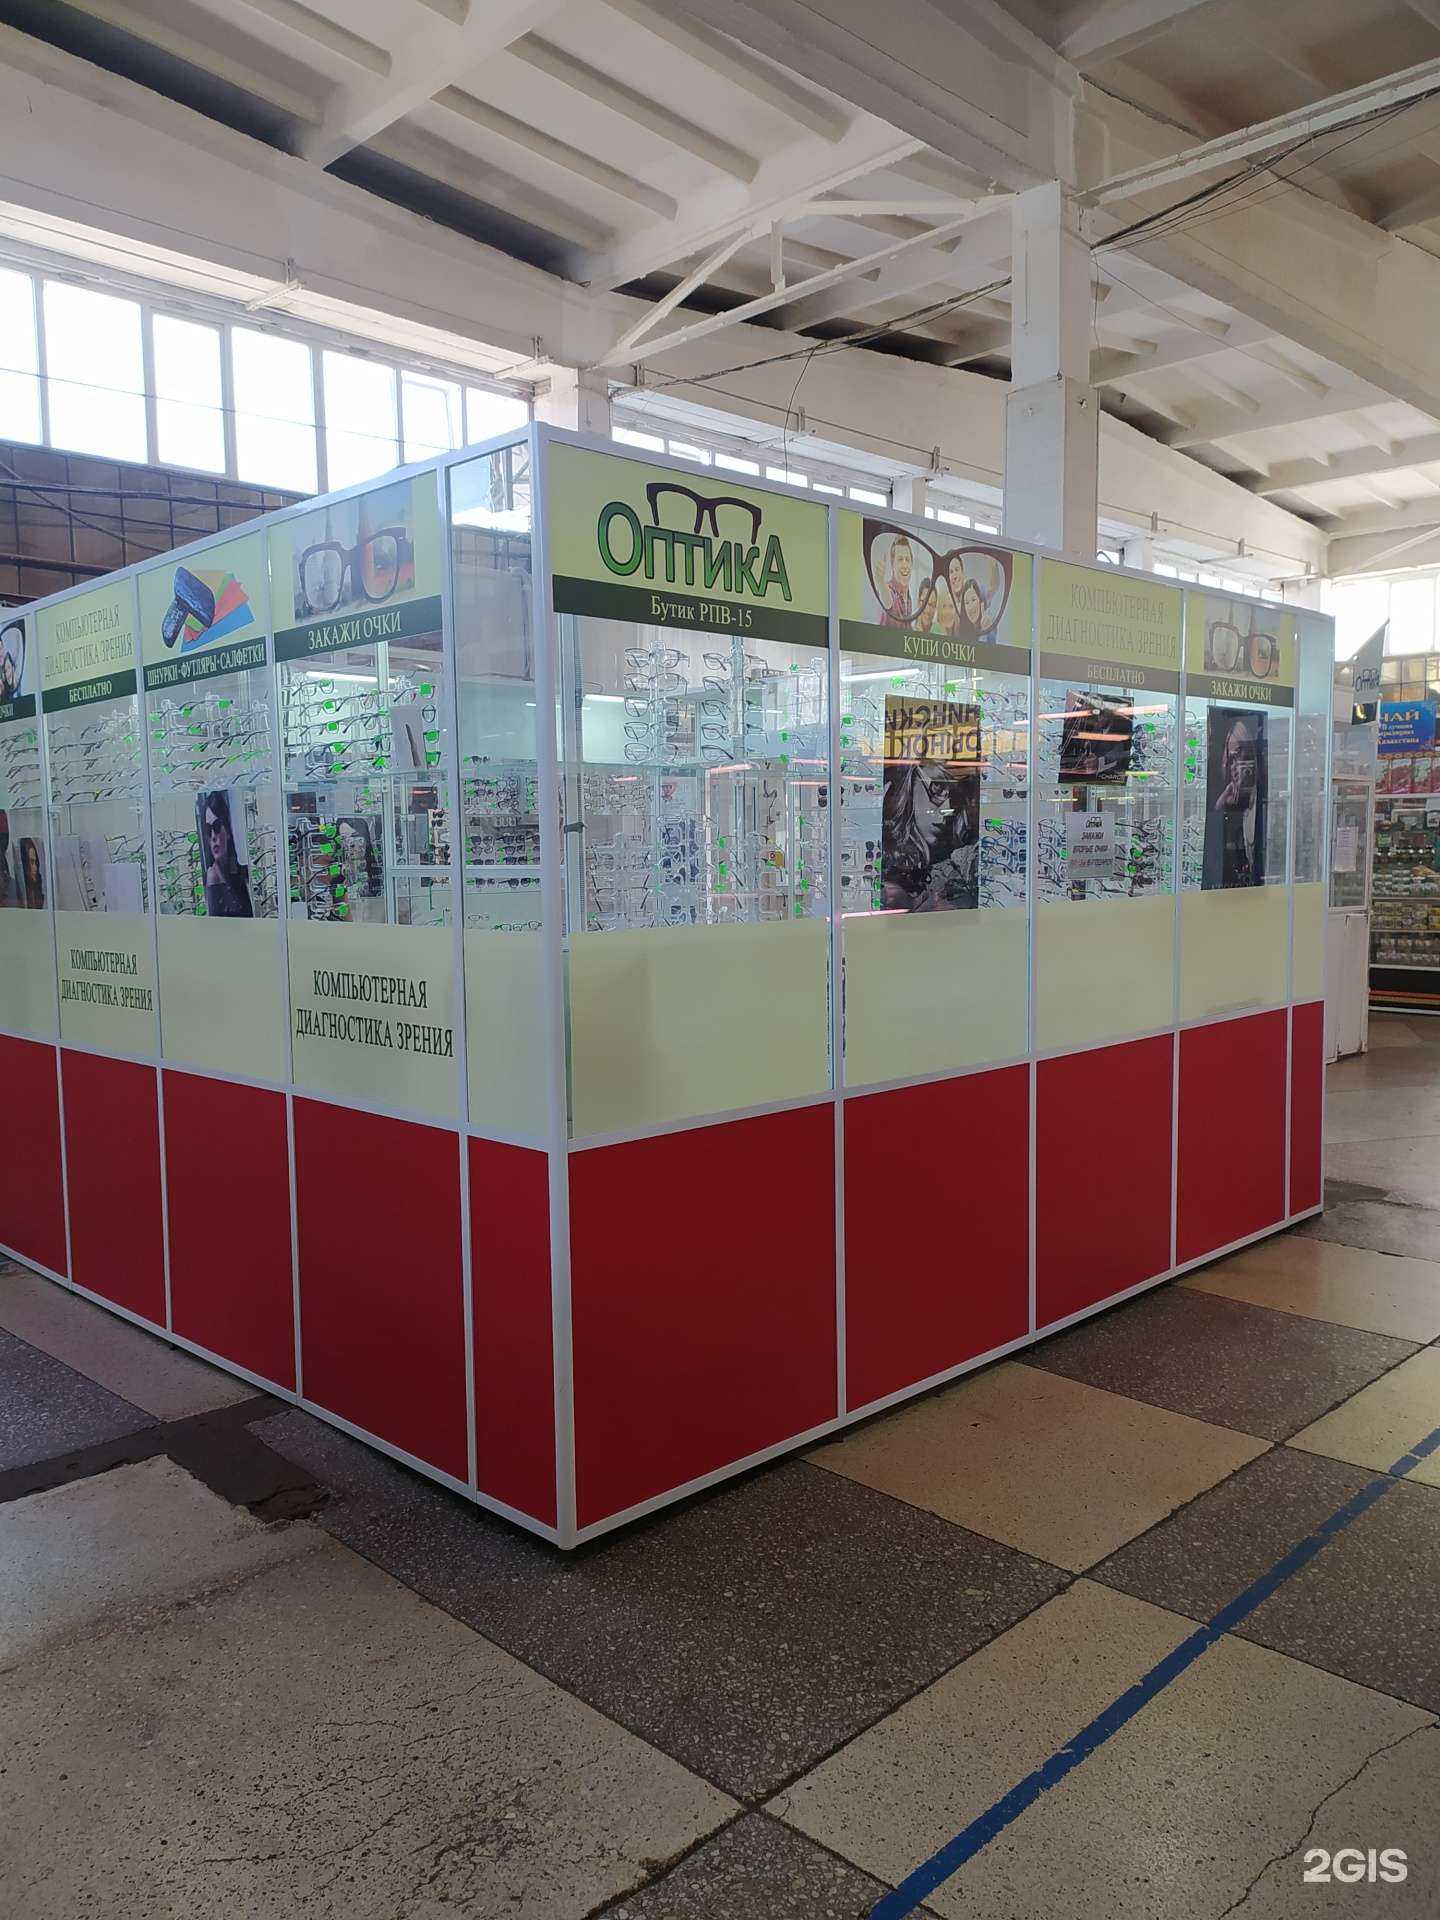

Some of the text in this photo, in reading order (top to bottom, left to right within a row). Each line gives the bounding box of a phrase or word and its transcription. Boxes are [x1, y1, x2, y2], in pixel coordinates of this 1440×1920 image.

[651, 595, 752, 628] Бутик РПВ-15
[1071, 583, 1164, 624] КОМПЬЮТЕРНАЯ
[56, 604, 120, 644] КОМПЬЮТЕРНАЯ
[308, 611, 401, 650] ЗАКАЖИ ОЧКИ
[1047, 614, 1177, 659] ДИАГНОСТИКА ЗРЕНИЯ
[45, 632, 134, 678] ДИАГНОСТИКА ЗРЕНИЯ
[220, 643, 265, 669] САЛФЕТКИ
[903, 635, 976, 662] КУПИ ОЧКИ
[1087, 664, 1145, 685] БЕСПЛАТНО
[1211, 680, 1272, 702] ЗАКАЖИ ОЧКИ
[69, 681, 112, 702] БЕСПЛАТНО
[70, 949, 138, 975] КОМПЬЮТЕРНАЯ
[61, 979, 153, 1011] ДИАГНОСТИКА ЗРЕНИЯ
[313, 969, 428, 1008] КОМПЬЮТЕРНАЯ
[296, 1008, 454, 1058] ДИАГНОСТИКА ЗРЕНИЯ
